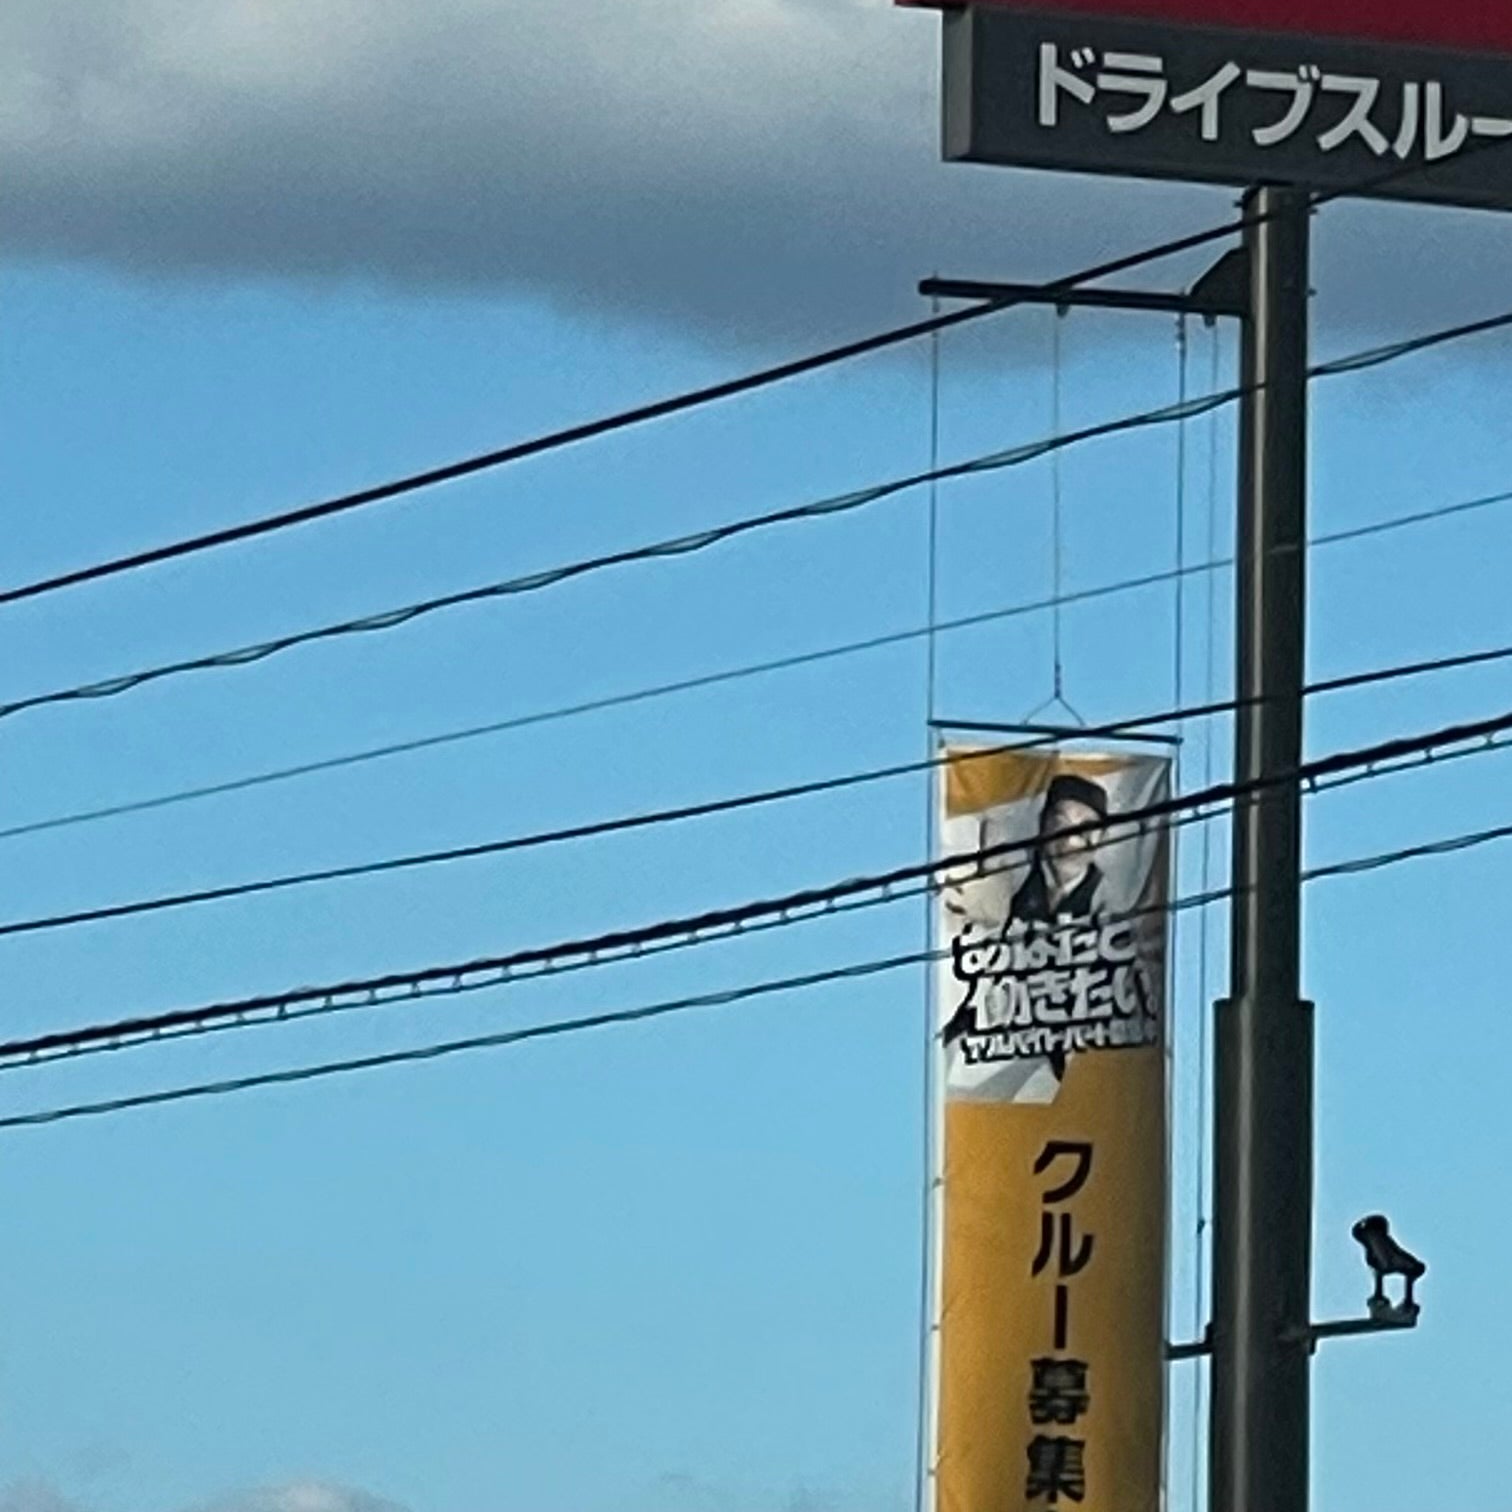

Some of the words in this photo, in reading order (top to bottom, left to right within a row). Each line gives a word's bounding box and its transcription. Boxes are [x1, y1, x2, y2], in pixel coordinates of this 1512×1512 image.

[1025, 1140, 1095, 1503] クルー募集
